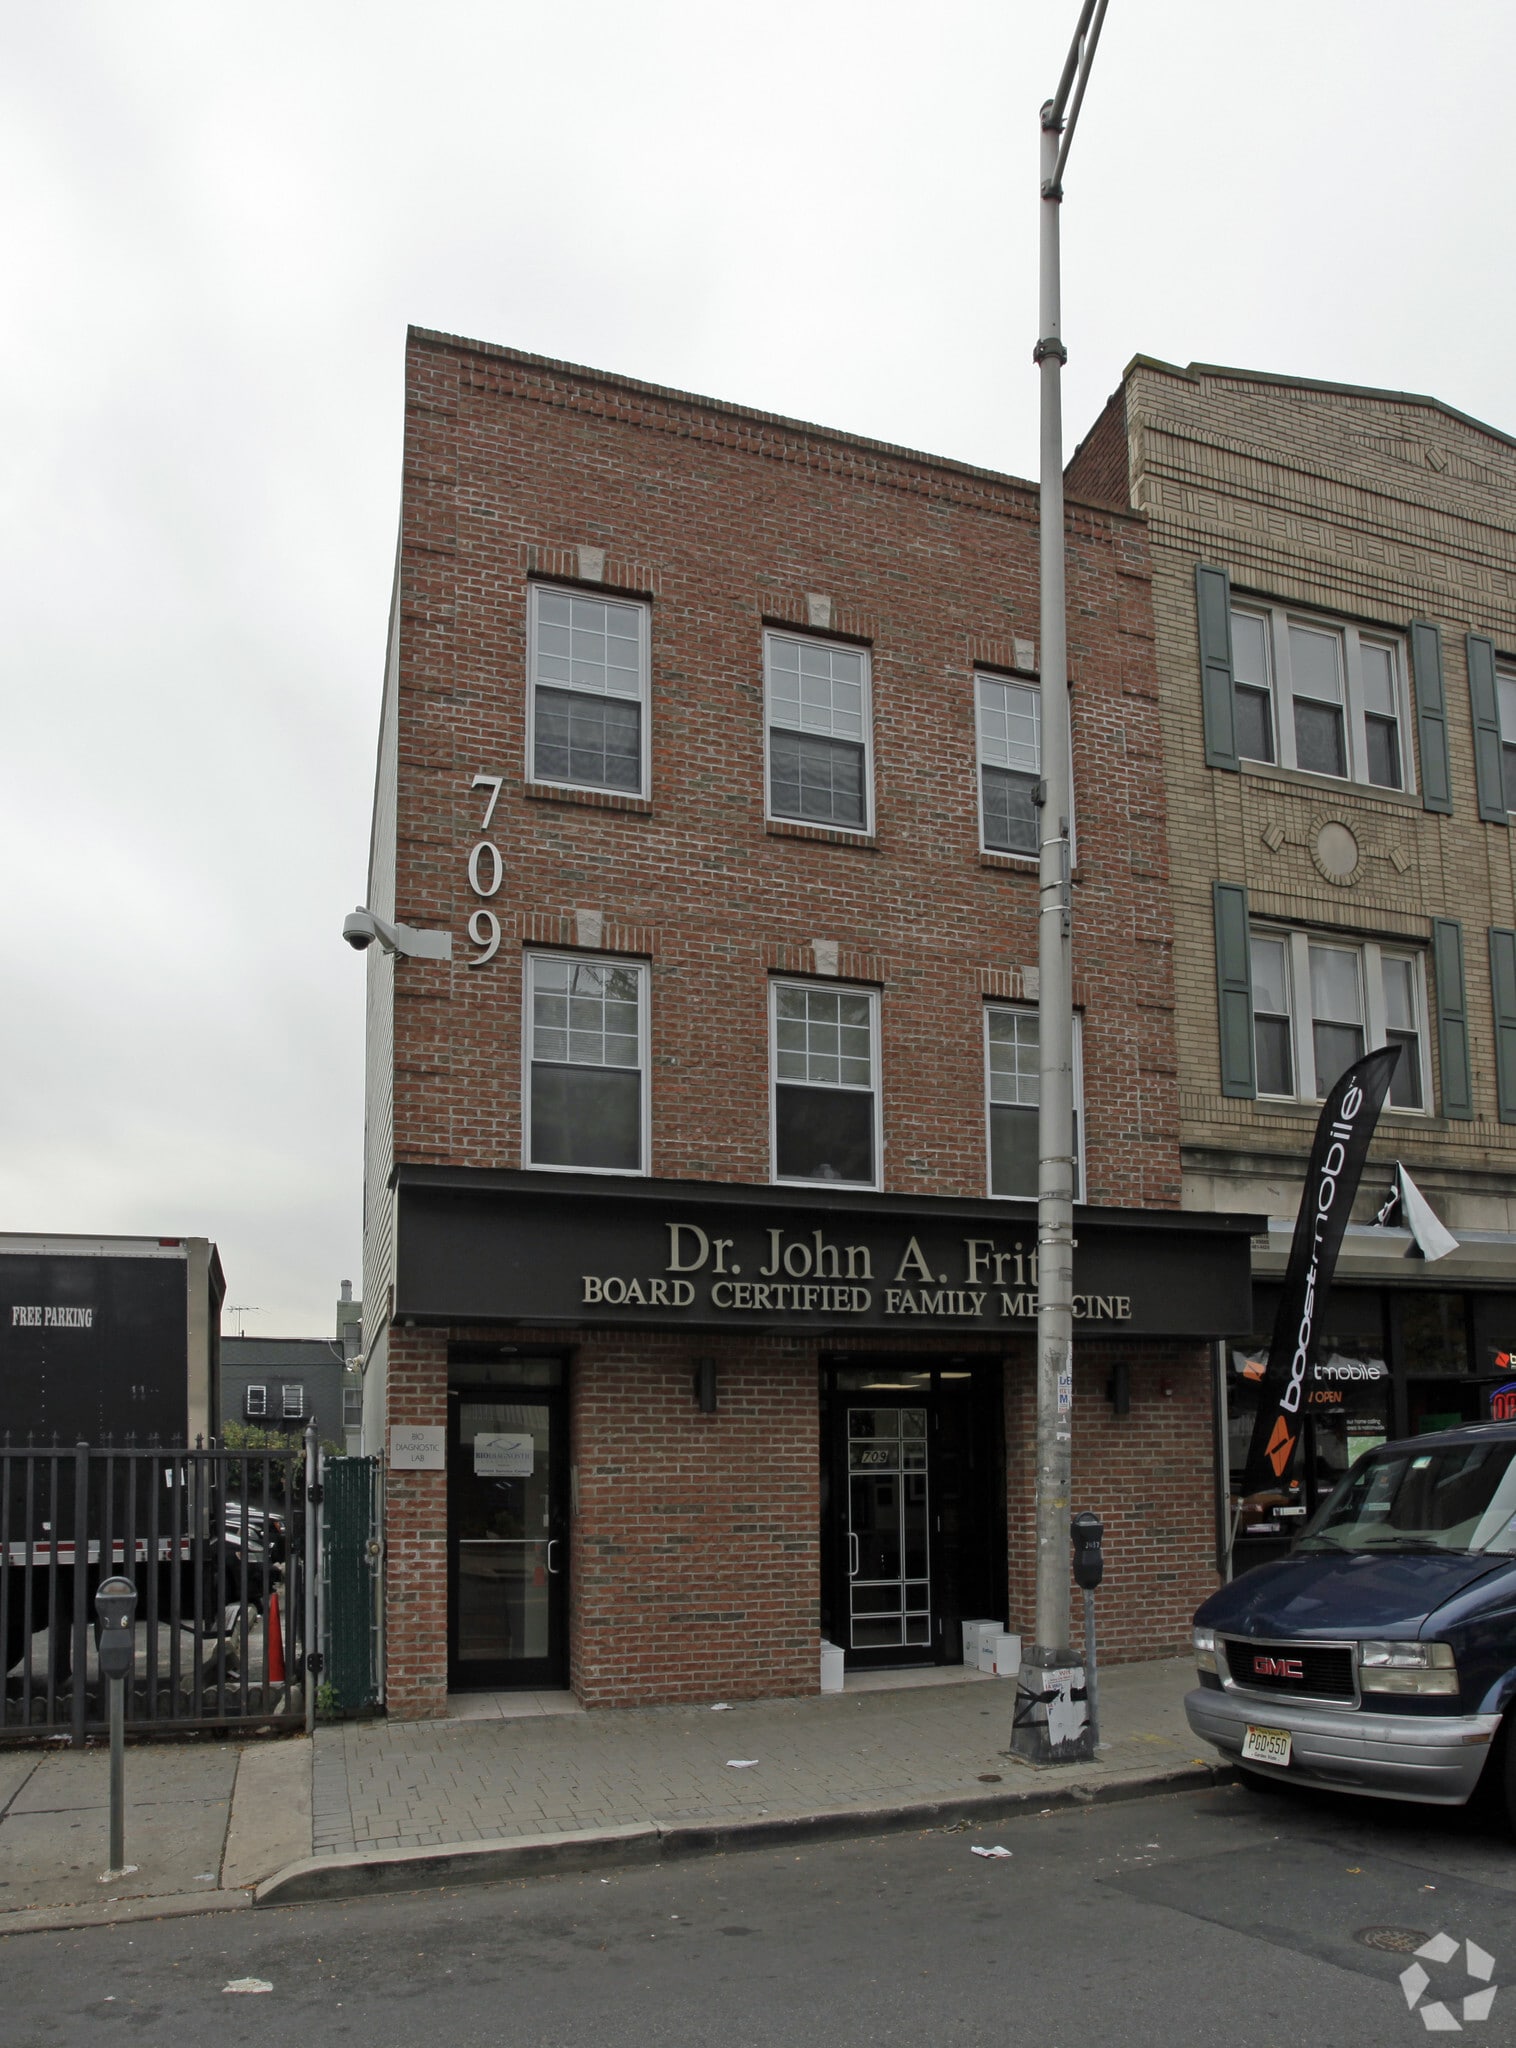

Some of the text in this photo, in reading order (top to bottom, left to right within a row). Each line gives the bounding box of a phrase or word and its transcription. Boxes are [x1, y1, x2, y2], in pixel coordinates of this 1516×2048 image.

[468, 775, 503, 965] 709
[665, 1223, 1039, 1287] Dr. John A. Frit
[582, 1276, 1132, 1320] BOARD CERTIFIED FAMILY MECINE
[12, 1305, 93, 1328] FREE PARKING
[1315, 1391, 1343, 1403] OPEN
[411, 1432, 425, 1441] BIO
[395, 1443, 440, 1452] DIAGNOSTIC
[411, 1454, 425, 1463] LAB
[863, 1451, 886, 1462] 709
[1254, 1656, 1303, 1678] GMC
